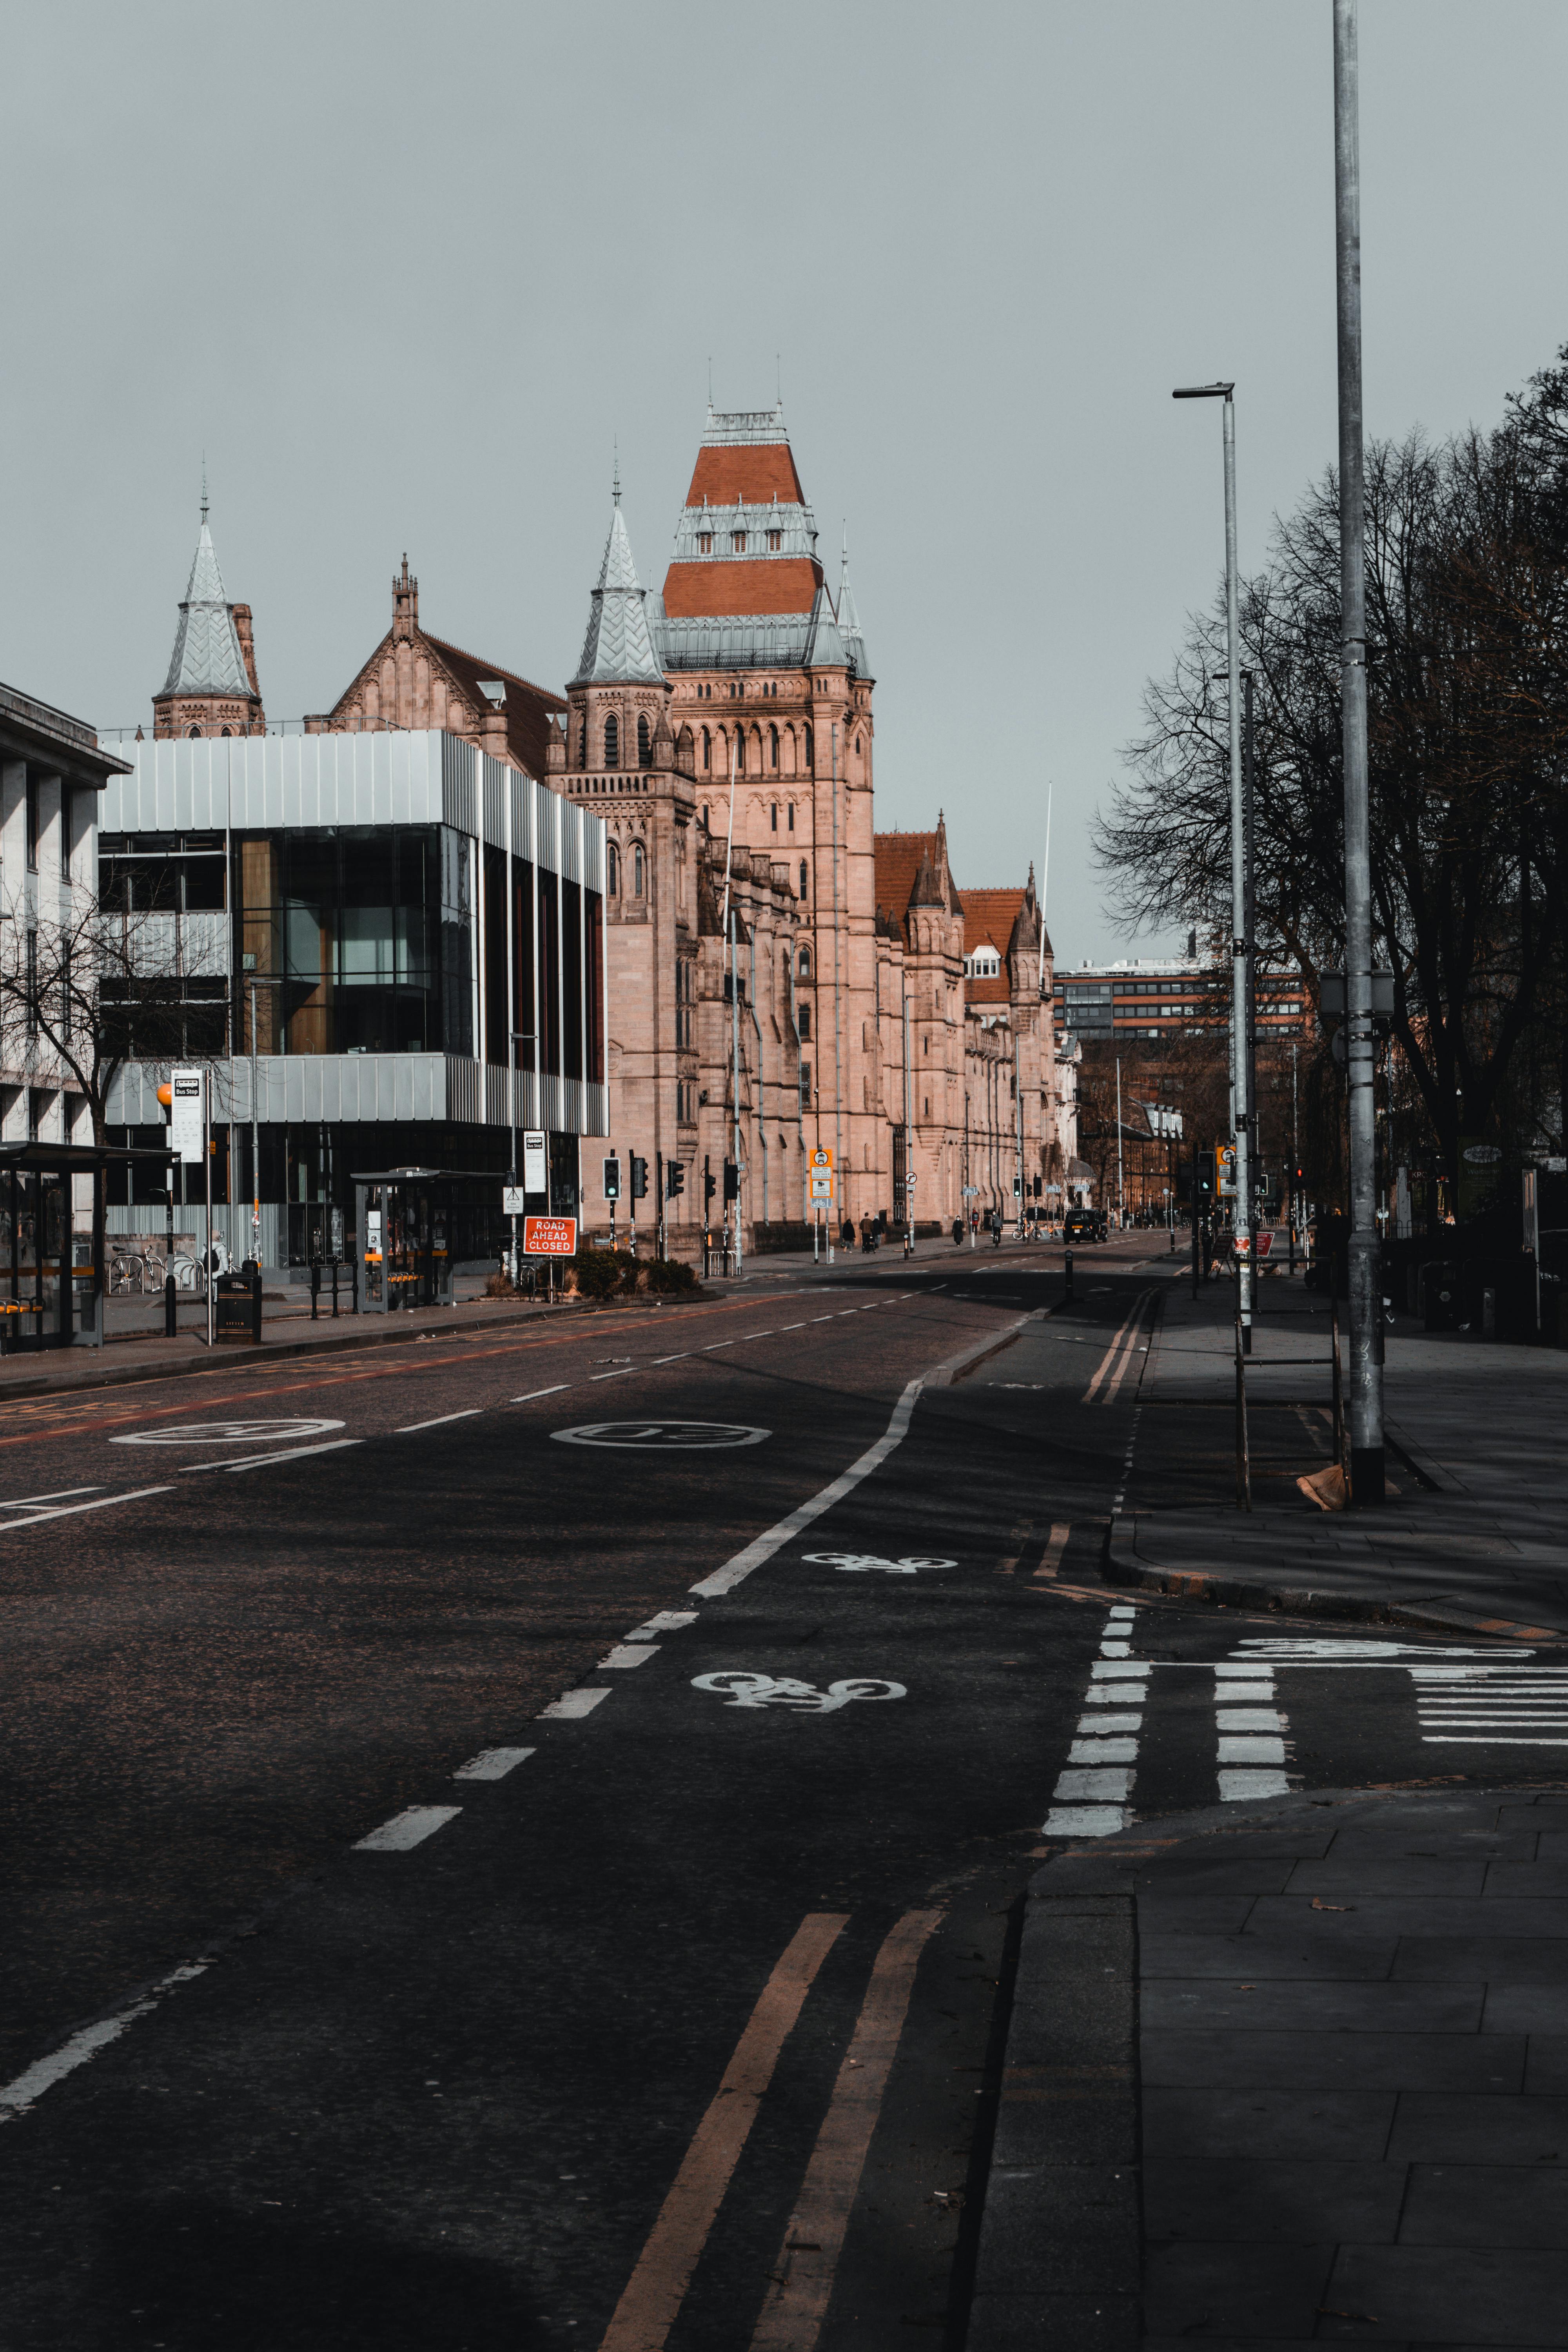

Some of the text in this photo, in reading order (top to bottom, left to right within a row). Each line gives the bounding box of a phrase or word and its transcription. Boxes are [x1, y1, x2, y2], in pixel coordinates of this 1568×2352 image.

[536, 1221, 565, 1230] ROAD
[532, 1231, 568, 1241] AHEAD
[529, 1241, 570, 1250] CLOSED
